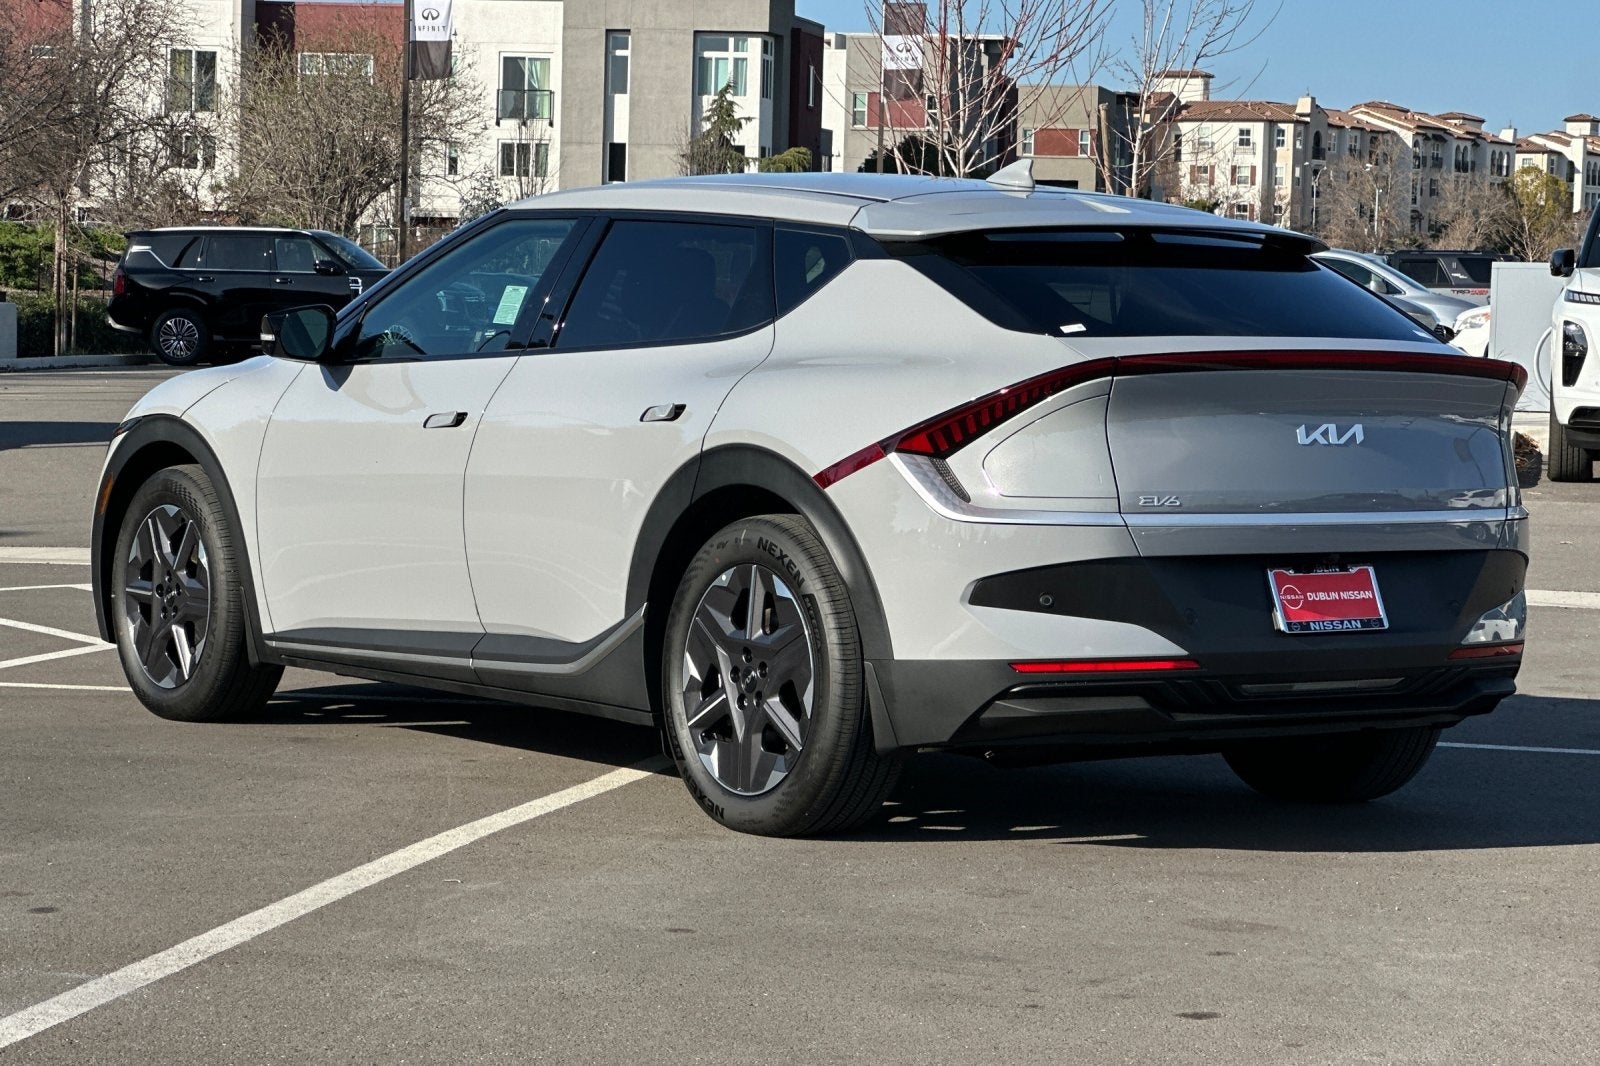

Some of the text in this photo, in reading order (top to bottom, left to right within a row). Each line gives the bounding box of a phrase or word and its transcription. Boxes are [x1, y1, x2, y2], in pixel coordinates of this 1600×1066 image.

[1296, 423, 1364, 445] KIA
[1139, 495, 1181, 506] EV6
[757, 537, 805, 588] NEXEN
[1306, 590, 1373, 601] DUBLIN NISSAN
[1310, 619, 1361, 631] NISSAN
